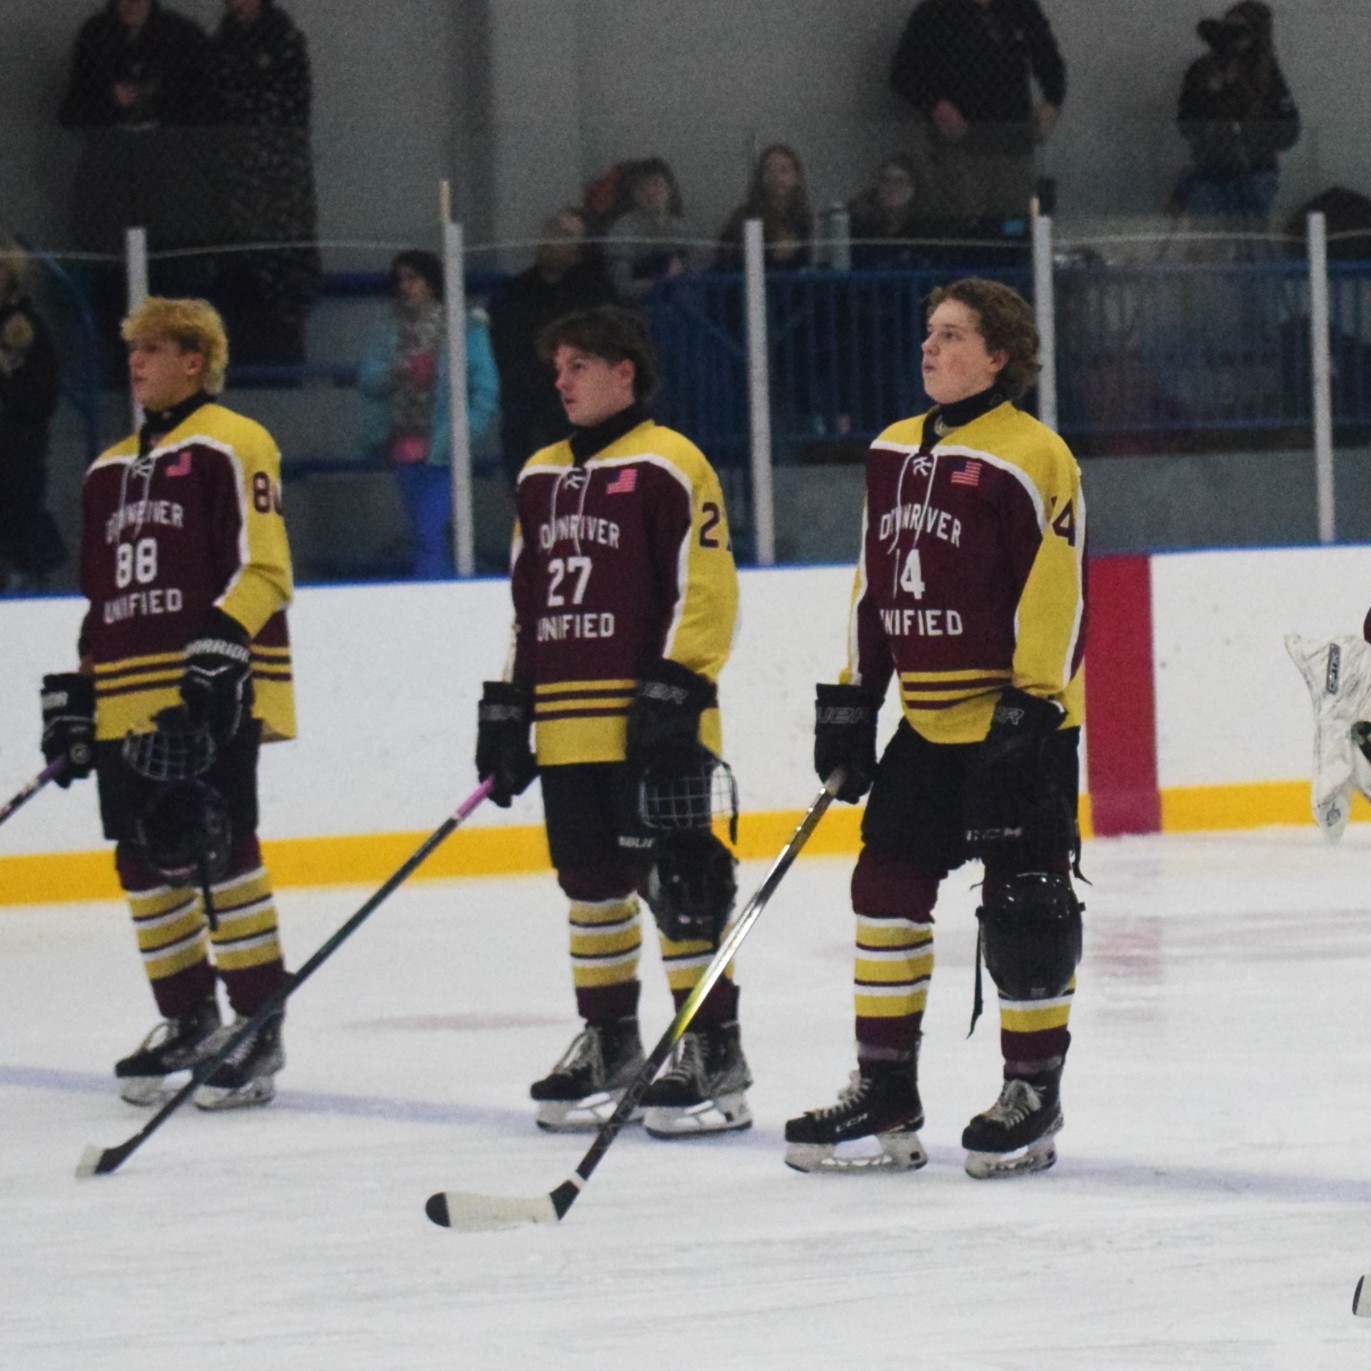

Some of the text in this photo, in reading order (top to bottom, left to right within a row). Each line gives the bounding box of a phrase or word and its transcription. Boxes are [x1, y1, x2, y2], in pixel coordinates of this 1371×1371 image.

[700, 502, 732, 551] 2
[1050, 496, 1075, 547] 4
[115, 537, 158, 588] 88
[547, 556, 593, 607] 27
